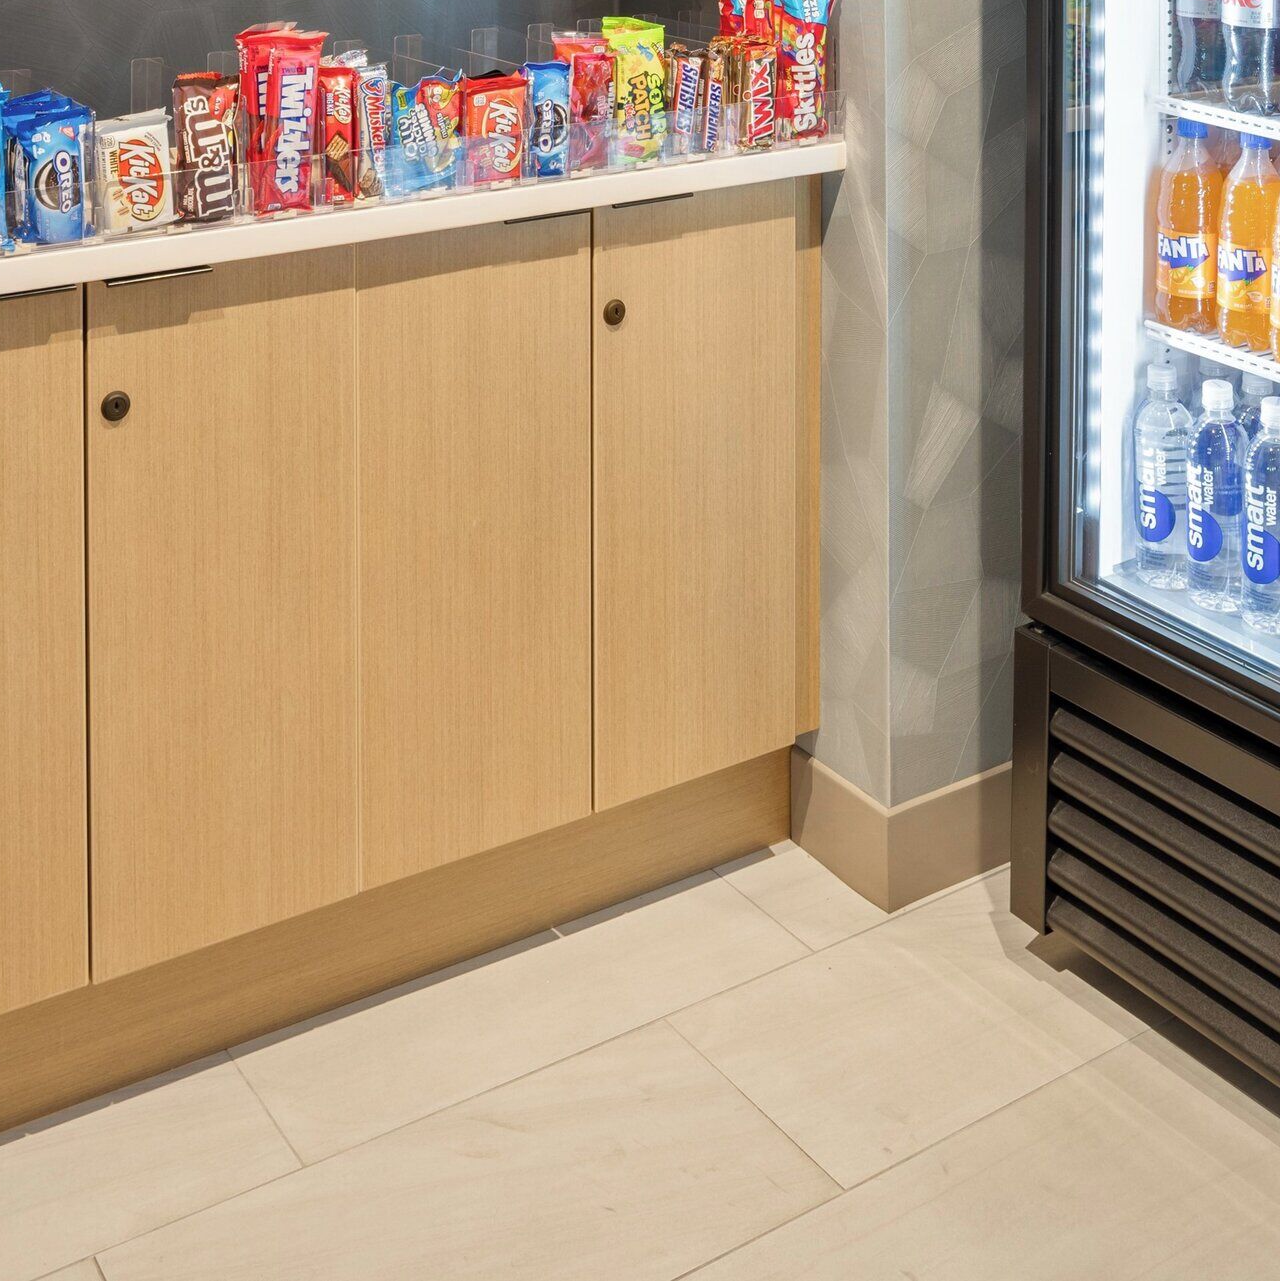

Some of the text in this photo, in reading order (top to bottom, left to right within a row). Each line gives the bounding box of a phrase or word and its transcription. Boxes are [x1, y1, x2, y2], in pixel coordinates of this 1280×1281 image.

[326, 92, 334, 116] BIG KAT
[748, 60, 774, 146] TWIX
[792, 33, 817, 133] Skittles
[276, 67, 314, 193] Twizzlers
[399, 116, 418, 161] JOLLY
[540, 98, 552, 152] OREO
[704, 82, 722, 151] SNICKERS
[54, 150, 72, 213] OREO
[110, 150, 119, 176] WHITE
[1185, 463, 1203, 549] smart
[1202, 467, 1214, 506] water
[1265, 486, 1278, 527] water
[1244, 474, 1266, 572] smart
